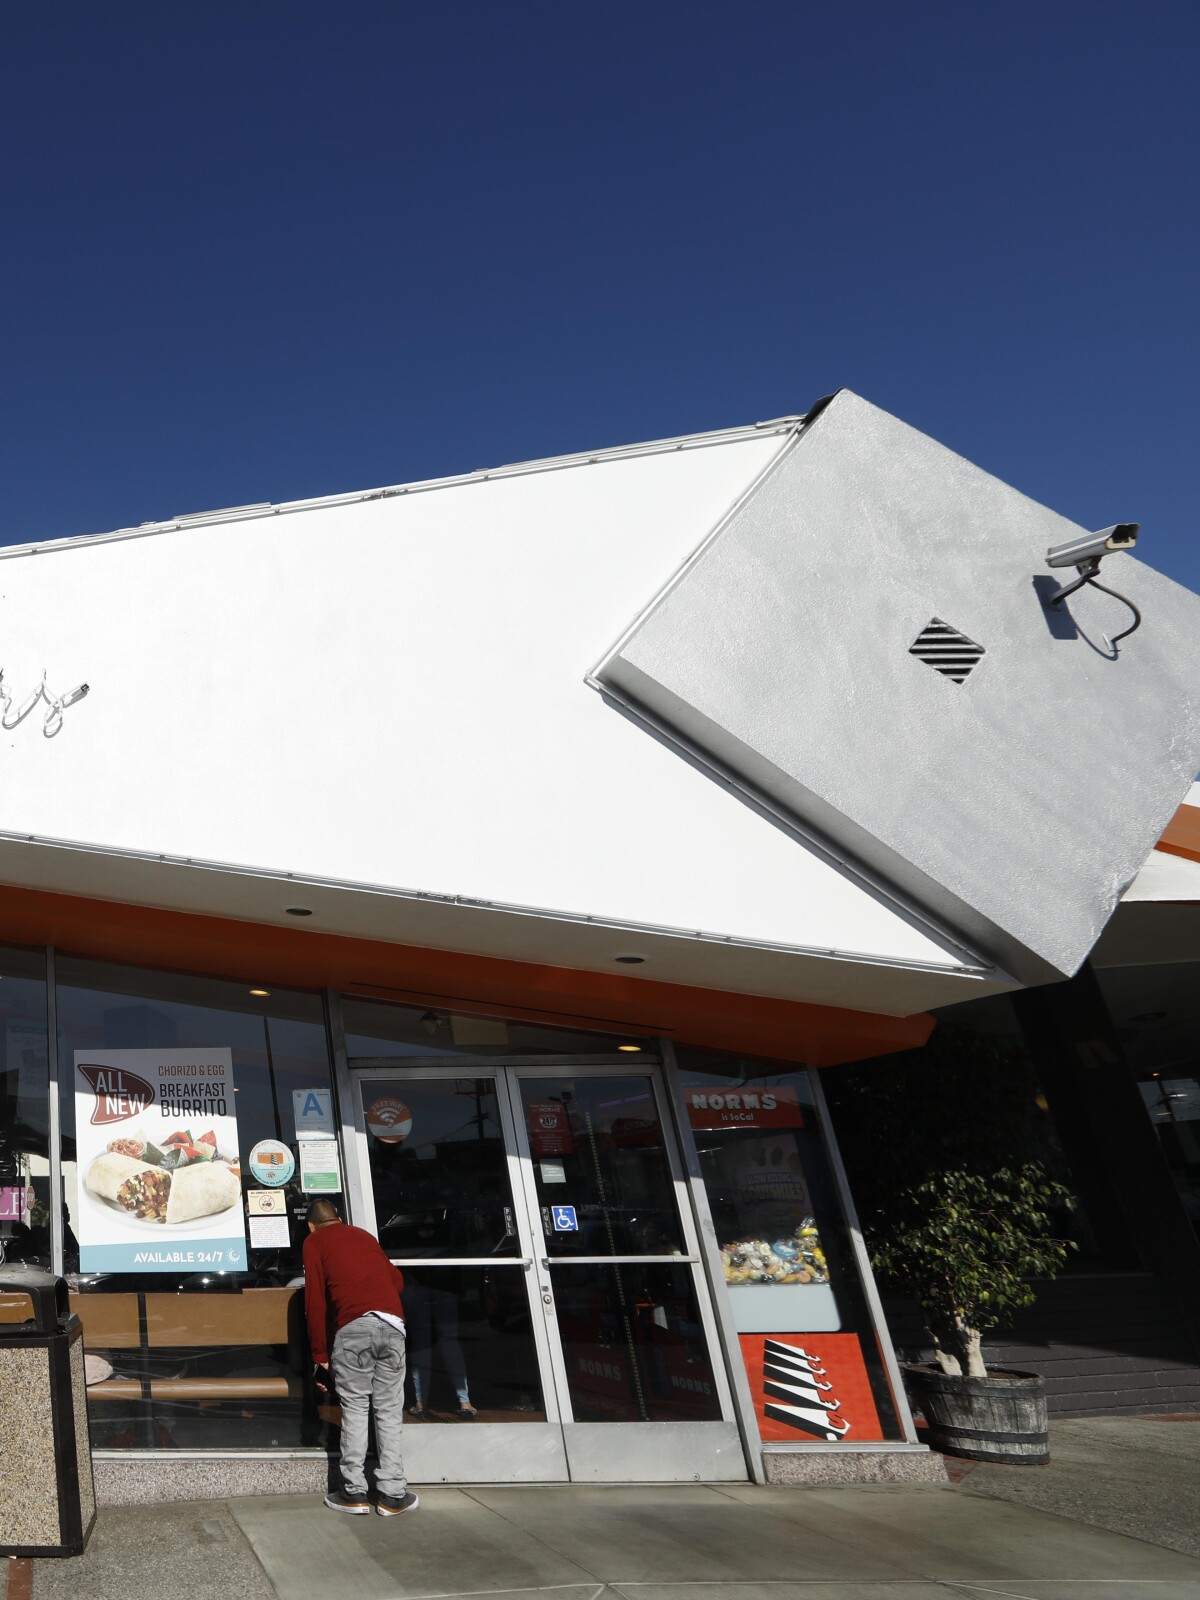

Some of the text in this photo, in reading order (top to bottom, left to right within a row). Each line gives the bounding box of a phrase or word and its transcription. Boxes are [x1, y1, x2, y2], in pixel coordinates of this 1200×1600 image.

[158, 1064, 225, 1077] CHORIZO & EGG
[96, 1071, 128, 1092] ALL
[159, 1082, 226, 1098] BREAKFAST
[105, 1093, 145, 1116] NEW
[160, 1098, 227, 1118] BURRITO
[302, 1092, 324, 1116] A
[691, 1093, 777, 1110] NORMS
[721, 1112, 754, 1121] is SoCal
[505, 1208, 513, 1235] PULL
[542, 1208, 551, 1235] PULL
[134, 1251, 224, 1263] AVAILABLE 24/7
[578, 1357, 622, 1382] NORMS
[671, 1375, 712, 1396] NORMS
